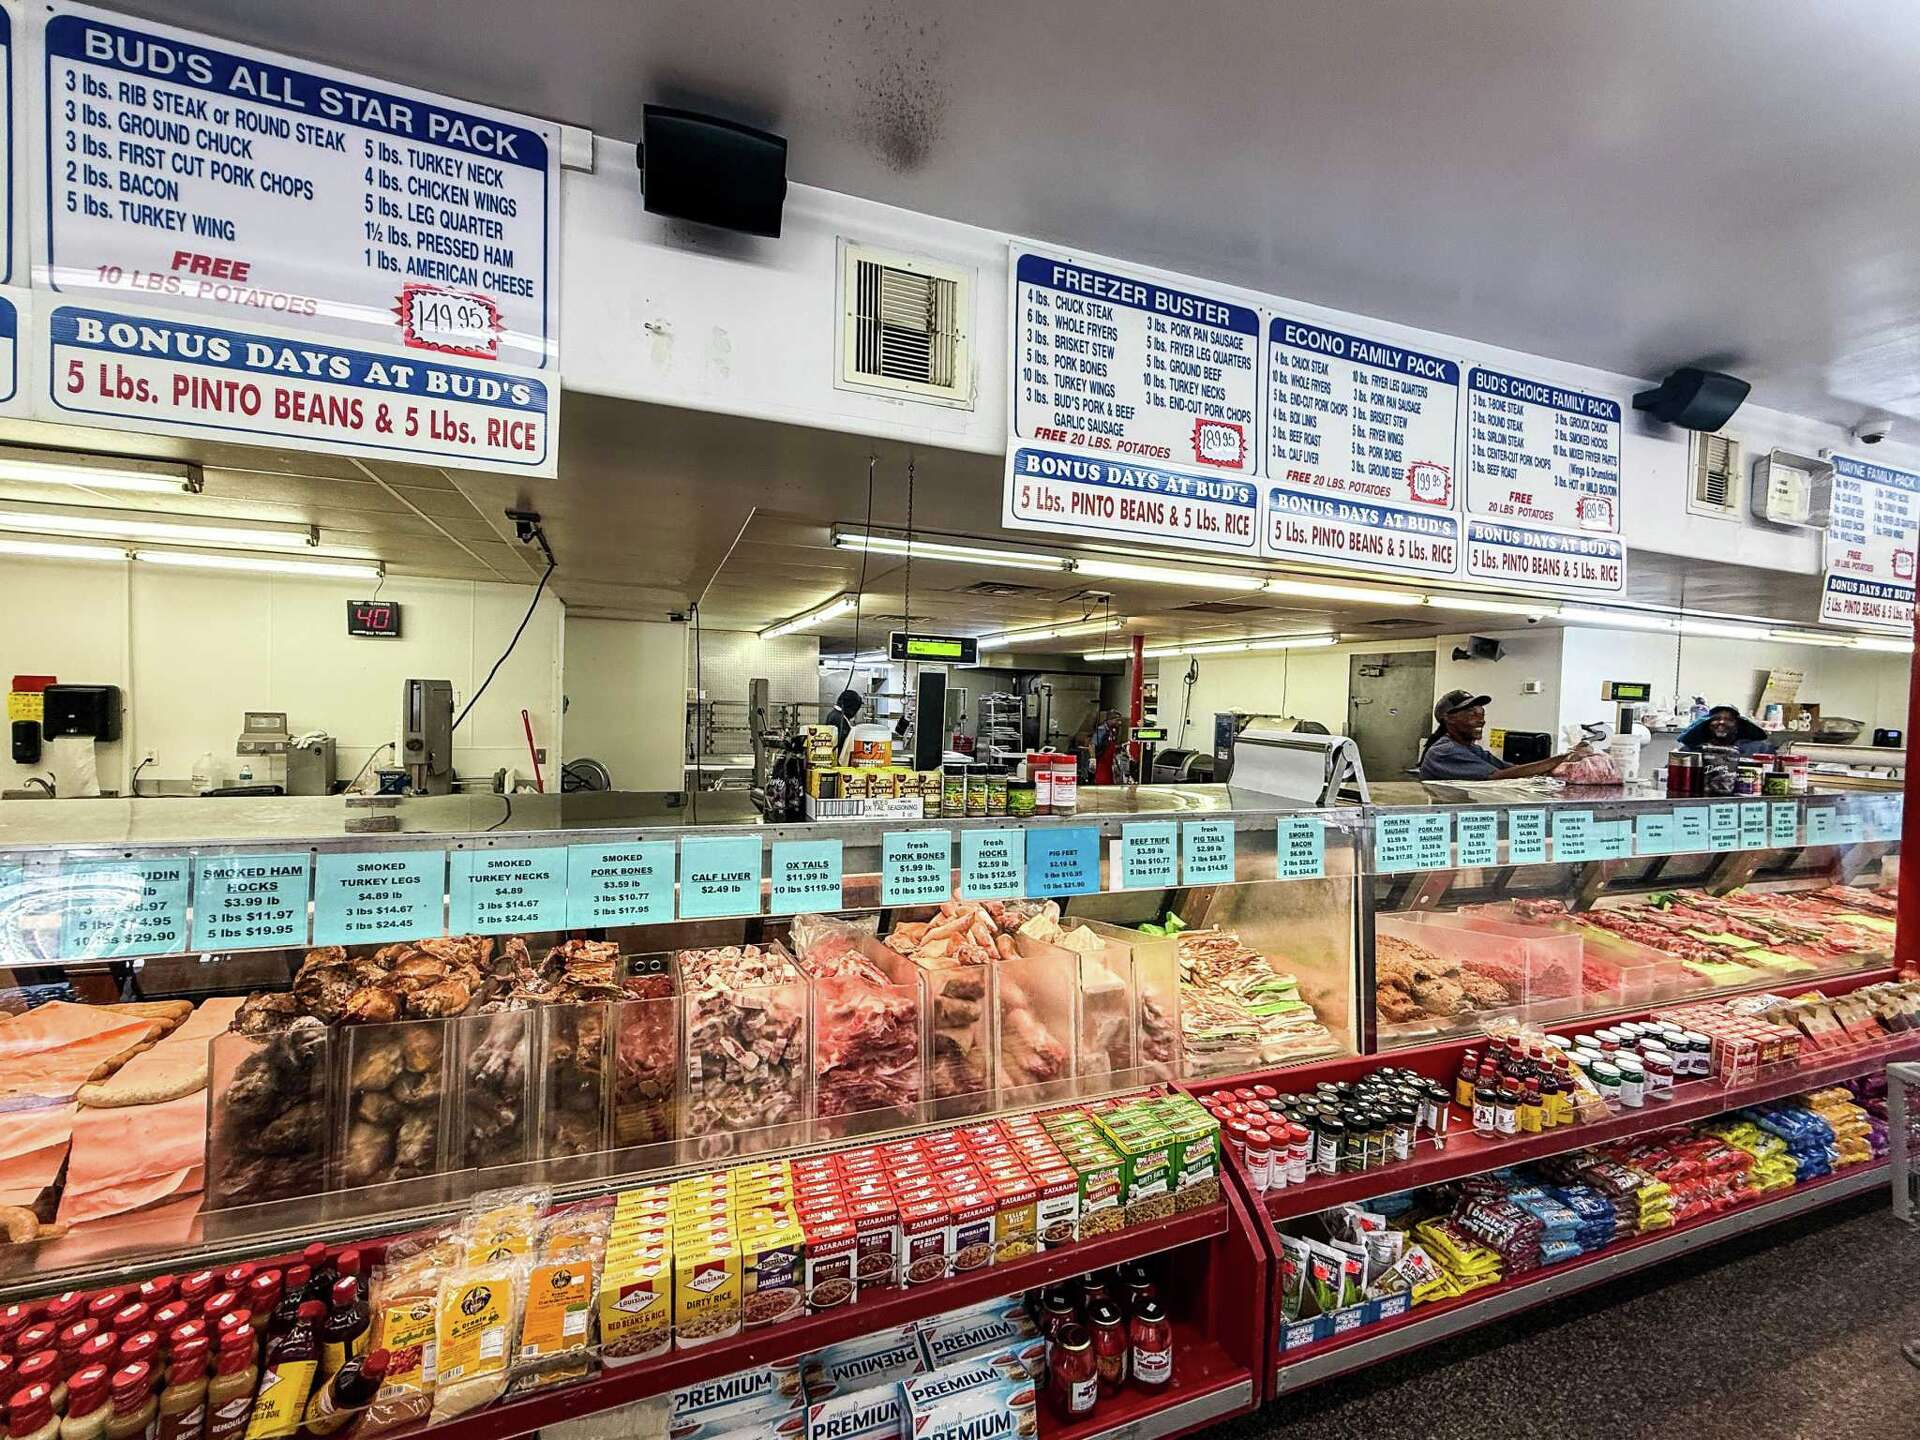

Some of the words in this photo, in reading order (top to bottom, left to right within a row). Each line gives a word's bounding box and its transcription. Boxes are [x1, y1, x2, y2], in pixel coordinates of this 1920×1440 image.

[85, 28, 213, 84] BUD'S
[229, 66, 305, 107] ALL
[319, 87, 413, 133] STAR
[429, 113, 518, 159] PACK
[66, 70, 76, 91] 3
[83, 74, 112, 99] lbs.
[119, 82, 146, 106] RIB
[153, 90, 208, 121] STEAK
[214, 108, 229, 125] or
[236, 109, 289, 138] ROUND
[296, 123, 346, 152] STEAK
[66, 100, 76, 121] 3
[83, 104, 112, 129] lbs.
[118, 112, 189, 145] GROUND
[196, 129, 252, 159] CHUCK
[66, 130, 76, 152] 3
[83, 134, 112, 159] lbs.
[119, 141, 165, 169] FIRST
[172, 153, 205, 178] CUT
[211, 161, 255, 188] PORK
[260, 171, 313, 200] CHOPS
[365, 139, 373, 158] 5
[379, 143, 402, 165] lbs.
[408, 149, 463, 178] TURKEY
[468, 163, 504, 188] NECK
[365, 167, 373, 185] 4
[379, 170, 402, 192] lbs.
[408, 176, 469, 207] CHICKEN
[474, 190, 517, 218] WINGS
[171, 251, 251, 282] FREE
[96, 265, 122, 284] 10
[131, 270, 185, 295] LBS.
[197, 282, 317, 316] POTATOES
[1053, 266, 1147, 305] FREEZER
[1155, 291, 1230, 326] BUSTER
[1285, 325, 1344, 354] ECONO
[1351, 342, 1402, 369] FAMILY
[1408, 356, 1446, 379] PACK
[76, 318, 231, 362] BONUS
[246, 343, 350, 379] DAYS
[364, 362, 413, 388] AT
[426, 370, 530, 405] BUD'S
[67, 360, 84, 393] 5
[100, 364, 157, 403] Lbs.
[173, 374, 261, 416] PINTO
[275, 389, 363, 429] BEANS
[375, 403, 393, 434] &
[405, 407, 418, 436] 5
[430, 410, 476, 444] Lbs.
[487, 418, 536, 451] RICE
[1511, 381, 1549, 403] CHOICE
[1553, 392, 1584, 412] FAMILY
[1588, 401, 1613, 418] PACK
[1035, 428, 1066, 442] FREE
[1071, 434, 1085, 446] 20
[1088, 437, 1113, 449] LBS.
[1117, 441, 1170, 459] POTATOES
[1026, 455, 1100, 481] BONUS
[1108, 467, 1159, 489] DAYS
[1165, 477, 1192, 494] AT
[1198, 482, 1249, 503] BUD'S
[1509, 492, 1532, 505] FREE
[1278, 494, 1334, 517] BONUS
[1339, 505, 1379, 523] DAYS
[1384, 514, 1403, 528] AT
[1408, 517, 1451, 535] BUD'S
[1831, 578, 1857, 592] BONUS
[1859, 584, 1880, 596] DAYS
[356, 609, 389, 628] 40
[602, 854, 643, 862] SMOKED
[916, 852, 945, 860] BONES
[357, 863, 405, 871] SMOKED
[488, 860, 532, 868] SMOKED
[203, 867, 265, 879] SMOKED
[271, 866, 302, 876] HAM
[468, 874, 511, 883] TURKEY
[591, 868, 617, 876] PORK
[722, 872, 750, 880] LIVER
[228, 882, 278, 892] HOCKS
[340, 878, 387, 887] TURKEY
[392, 876, 420, 884] LEGS
[604, 881, 629, 889] $3.59
[359, 892, 388, 901] $4.89
[393, 891, 402, 899] lb
[496, 887, 523, 896] $4.89
[702, 886, 728, 894] $2.49
[732, 885, 740, 893] lb
[224, 897, 262, 908] $3.99
[267, 896, 279, 905] lb
[209, 915, 217, 923] 3
[221, 913, 241, 922] lbs
[246, 910, 294, 921] $11.97
[1044, 1182, 1077, 1195] ZATARAIN'S
[1001, 1192, 1036, 1205] ZATARAIN'S
[959, 1205, 994, 1220] ZATARAIN'S
[1005, 1210, 1029, 1220] YELLOW
[857, 1214, 897, 1227] ZATARAIN'S
[911, 1215, 949, 1230] ZATARAIN'S
[814, 1239, 855, 1252] ZATARAIN'S
[815, 1264, 833, 1272] DIRTY
[694, 1275, 725, 1287] LOUISIANA
[759, 1274, 791, 1287] JAMBALAYA
[619, 1294, 653, 1307] LOUISIANA
[687, 1298, 710, 1310] DIRTY
[714, 1291, 731, 1302] RICE
[608, 1321, 620, 1331] RED
[623, 1316, 643, 1328] BEANS
[651, 1310, 665, 1321] RICE
[931, 1322, 1011, 1355] PREMIUM
[833, 1347, 918, 1381] PREMIUM
[675, 1372, 771, 1411] PREMIUM
[912, 1368, 998, 1401] PREMIUM
